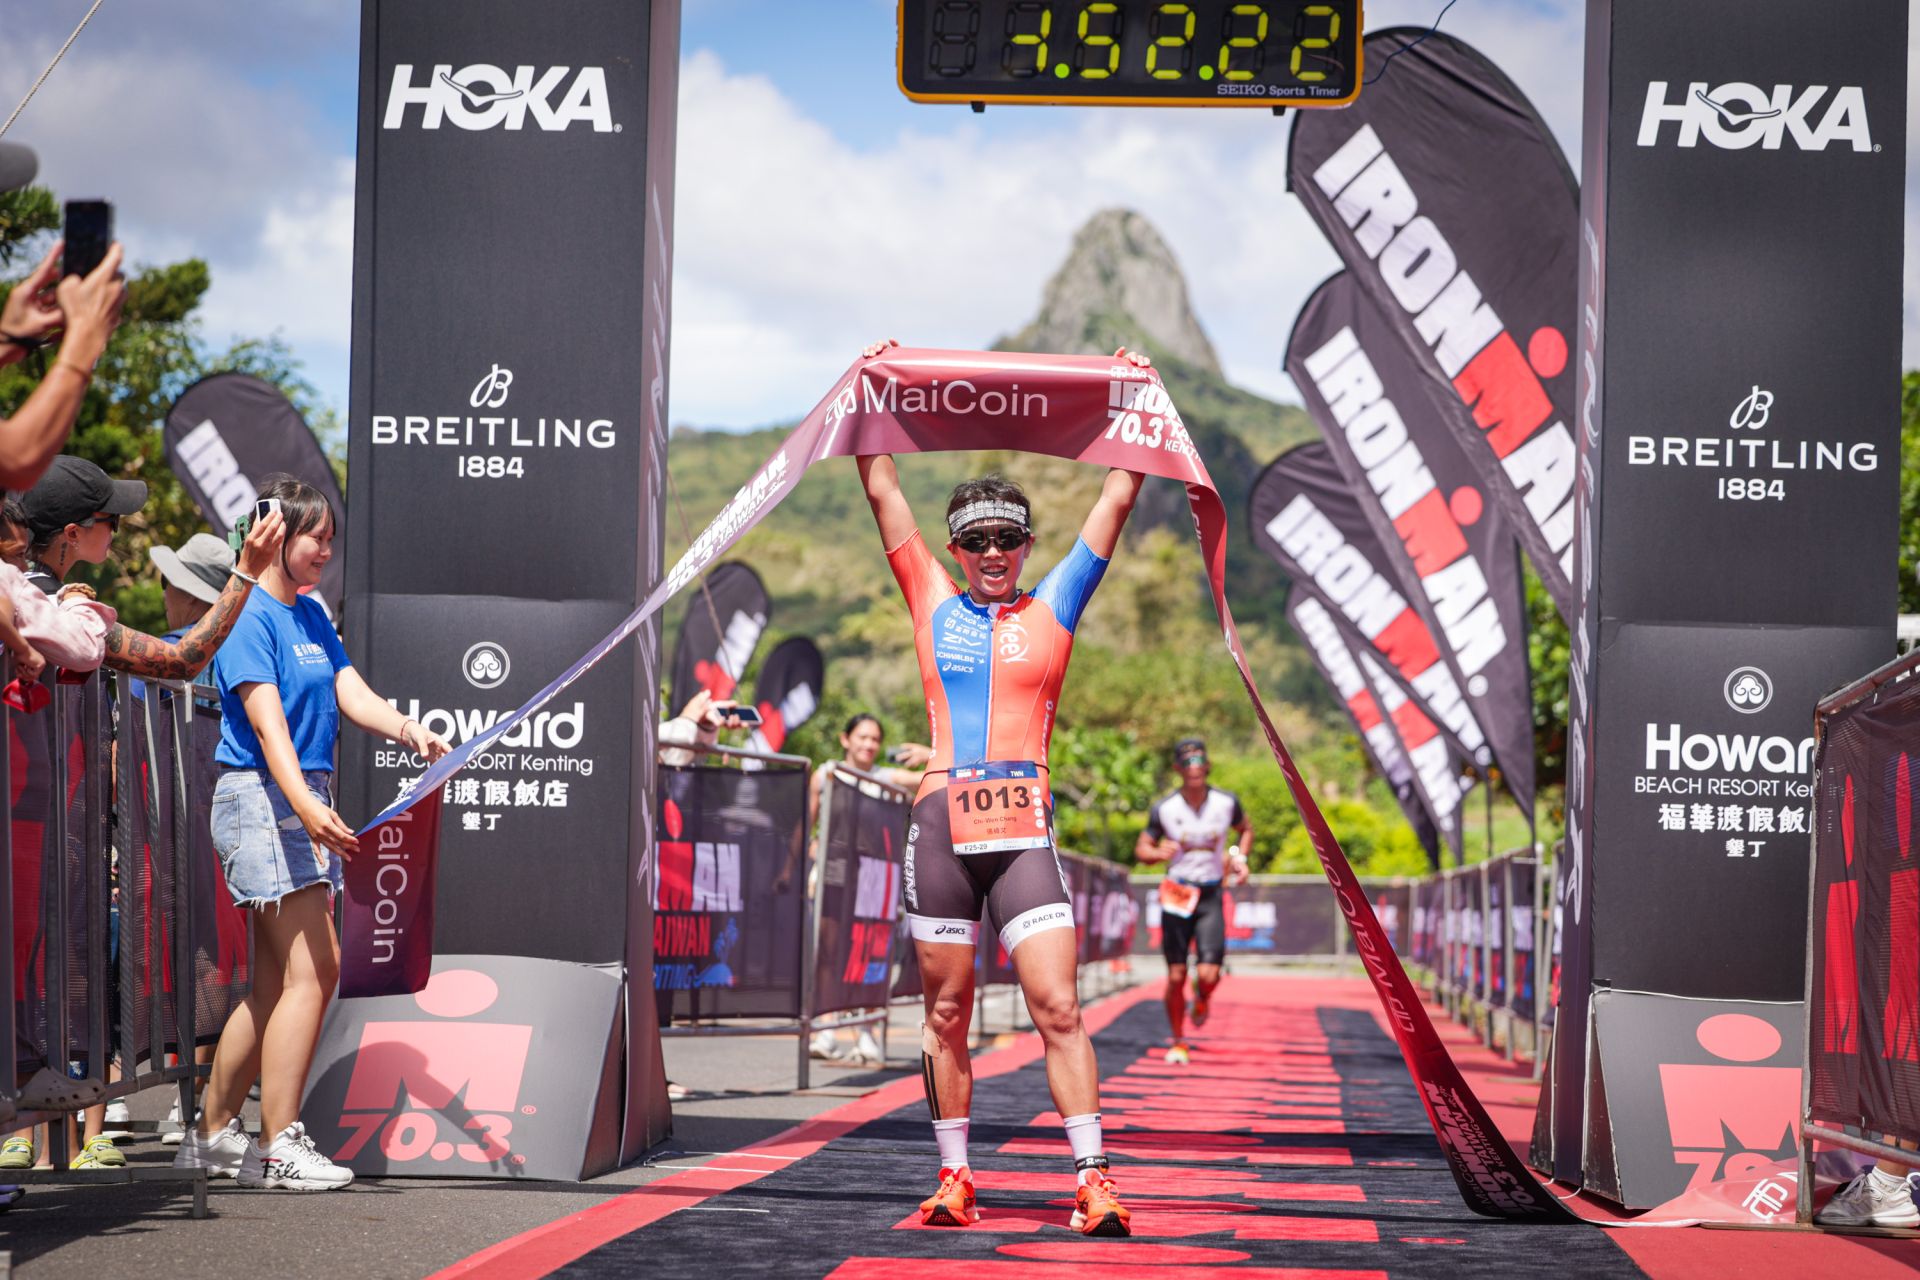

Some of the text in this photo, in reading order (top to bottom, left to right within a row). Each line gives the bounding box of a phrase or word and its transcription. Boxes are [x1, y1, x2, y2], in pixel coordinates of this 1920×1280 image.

[383, 63, 613, 132] HOKA
[1216, 83, 1341, 98] SEIKO Sports Timer
[1637, 81, 1872, 152] HOKA
[861, 374, 1049, 418] MaiCoin
[372, 416, 616, 449] BREITLING
[1104, 409, 1164, 449] 70.3
[458, 456, 524, 479] 1884
[1628, 436, 1878, 472] BREITLING
[1304, 325, 1507, 679] IRONMAN
[1718, 477, 1786, 502] 1884
[667, 449, 789, 586] IRONMAN
[520, 753, 593, 776] Kenting
[1645, 722, 1815, 774] Howar
[955, 785, 1031, 814] 1013
[1634, 776, 1702, 795] BEACH
[1708, 779, 1780, 797] RESORT
[461, 811, 502, 831] 墾丁
[1658, 803, 1815, 834] 福華渡假飯
[1726, 838, 1767, 858] 墾丁
[946, 927, 966, 935] asics
[1032, 910, 1066, 926] RACE ON
[653, 914, 711, 957] AIWAN
[331, 1112, 513, 1163] 70.3
[1421, 1080, 1526, 1214] IRONMAN
[1451, 1111, 1495, 1170] TAIWAN
[1470, 1119, 1506, 1168] KENTING
[260, 1157, 301, 1180] Fila
